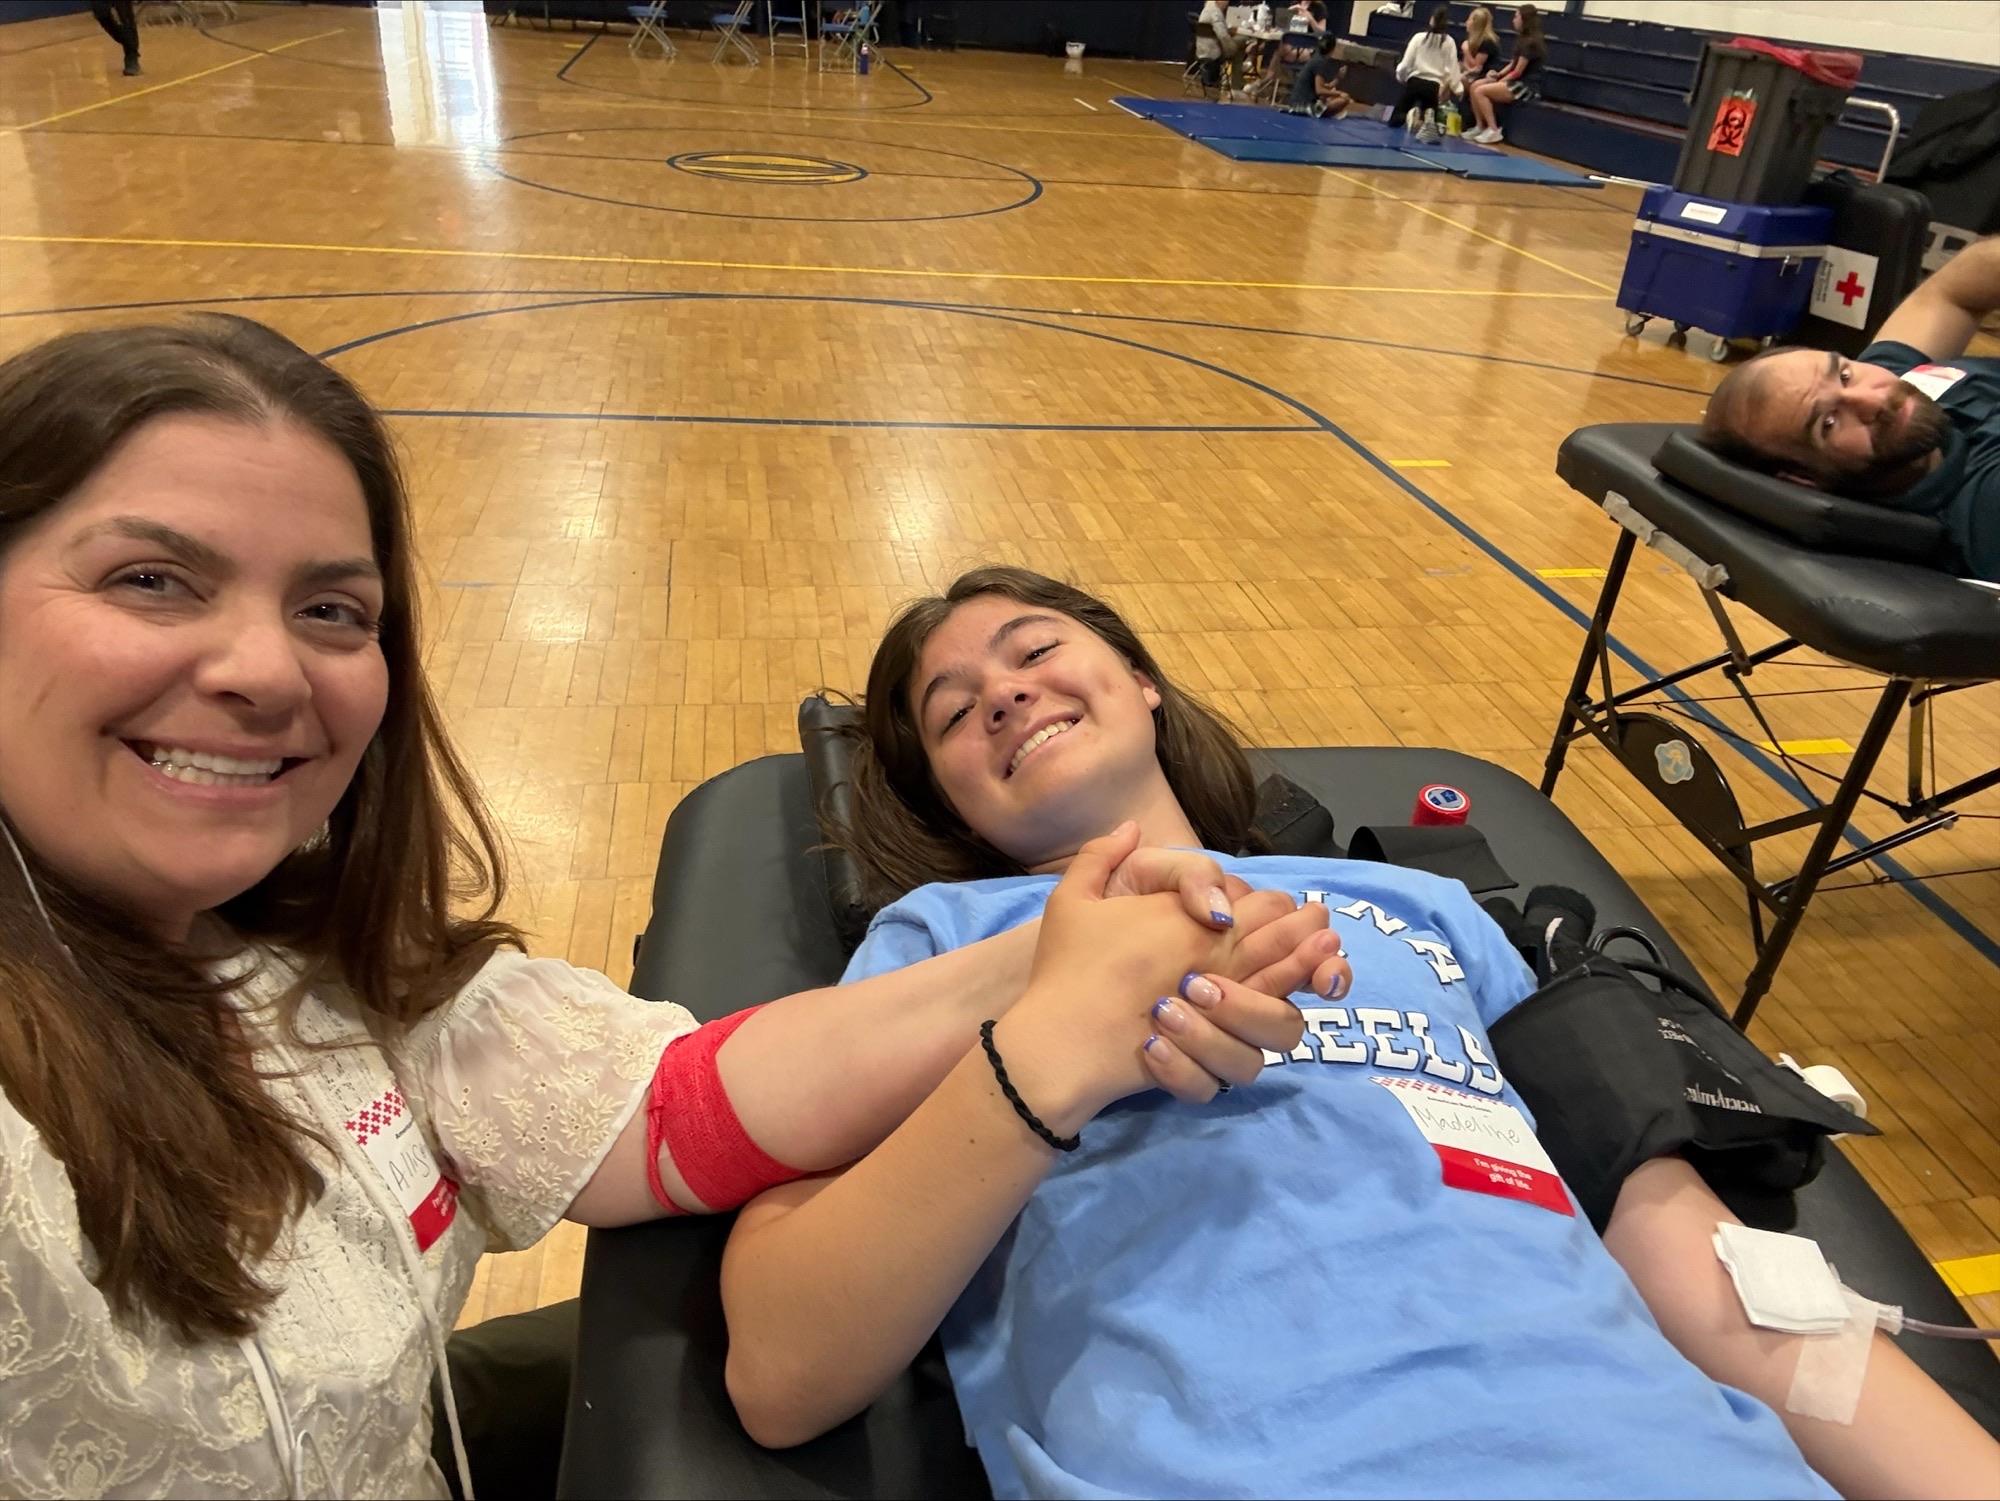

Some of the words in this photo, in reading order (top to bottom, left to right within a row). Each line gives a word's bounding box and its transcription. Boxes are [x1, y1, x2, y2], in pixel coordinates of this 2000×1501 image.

[1412, 1105, 1520, 1147] Madeline
[1490, 1164, 1517, 1177] giving
[1516, 1170, 1532, 1180] the
[1505, 1177, 1514, 1185] of
